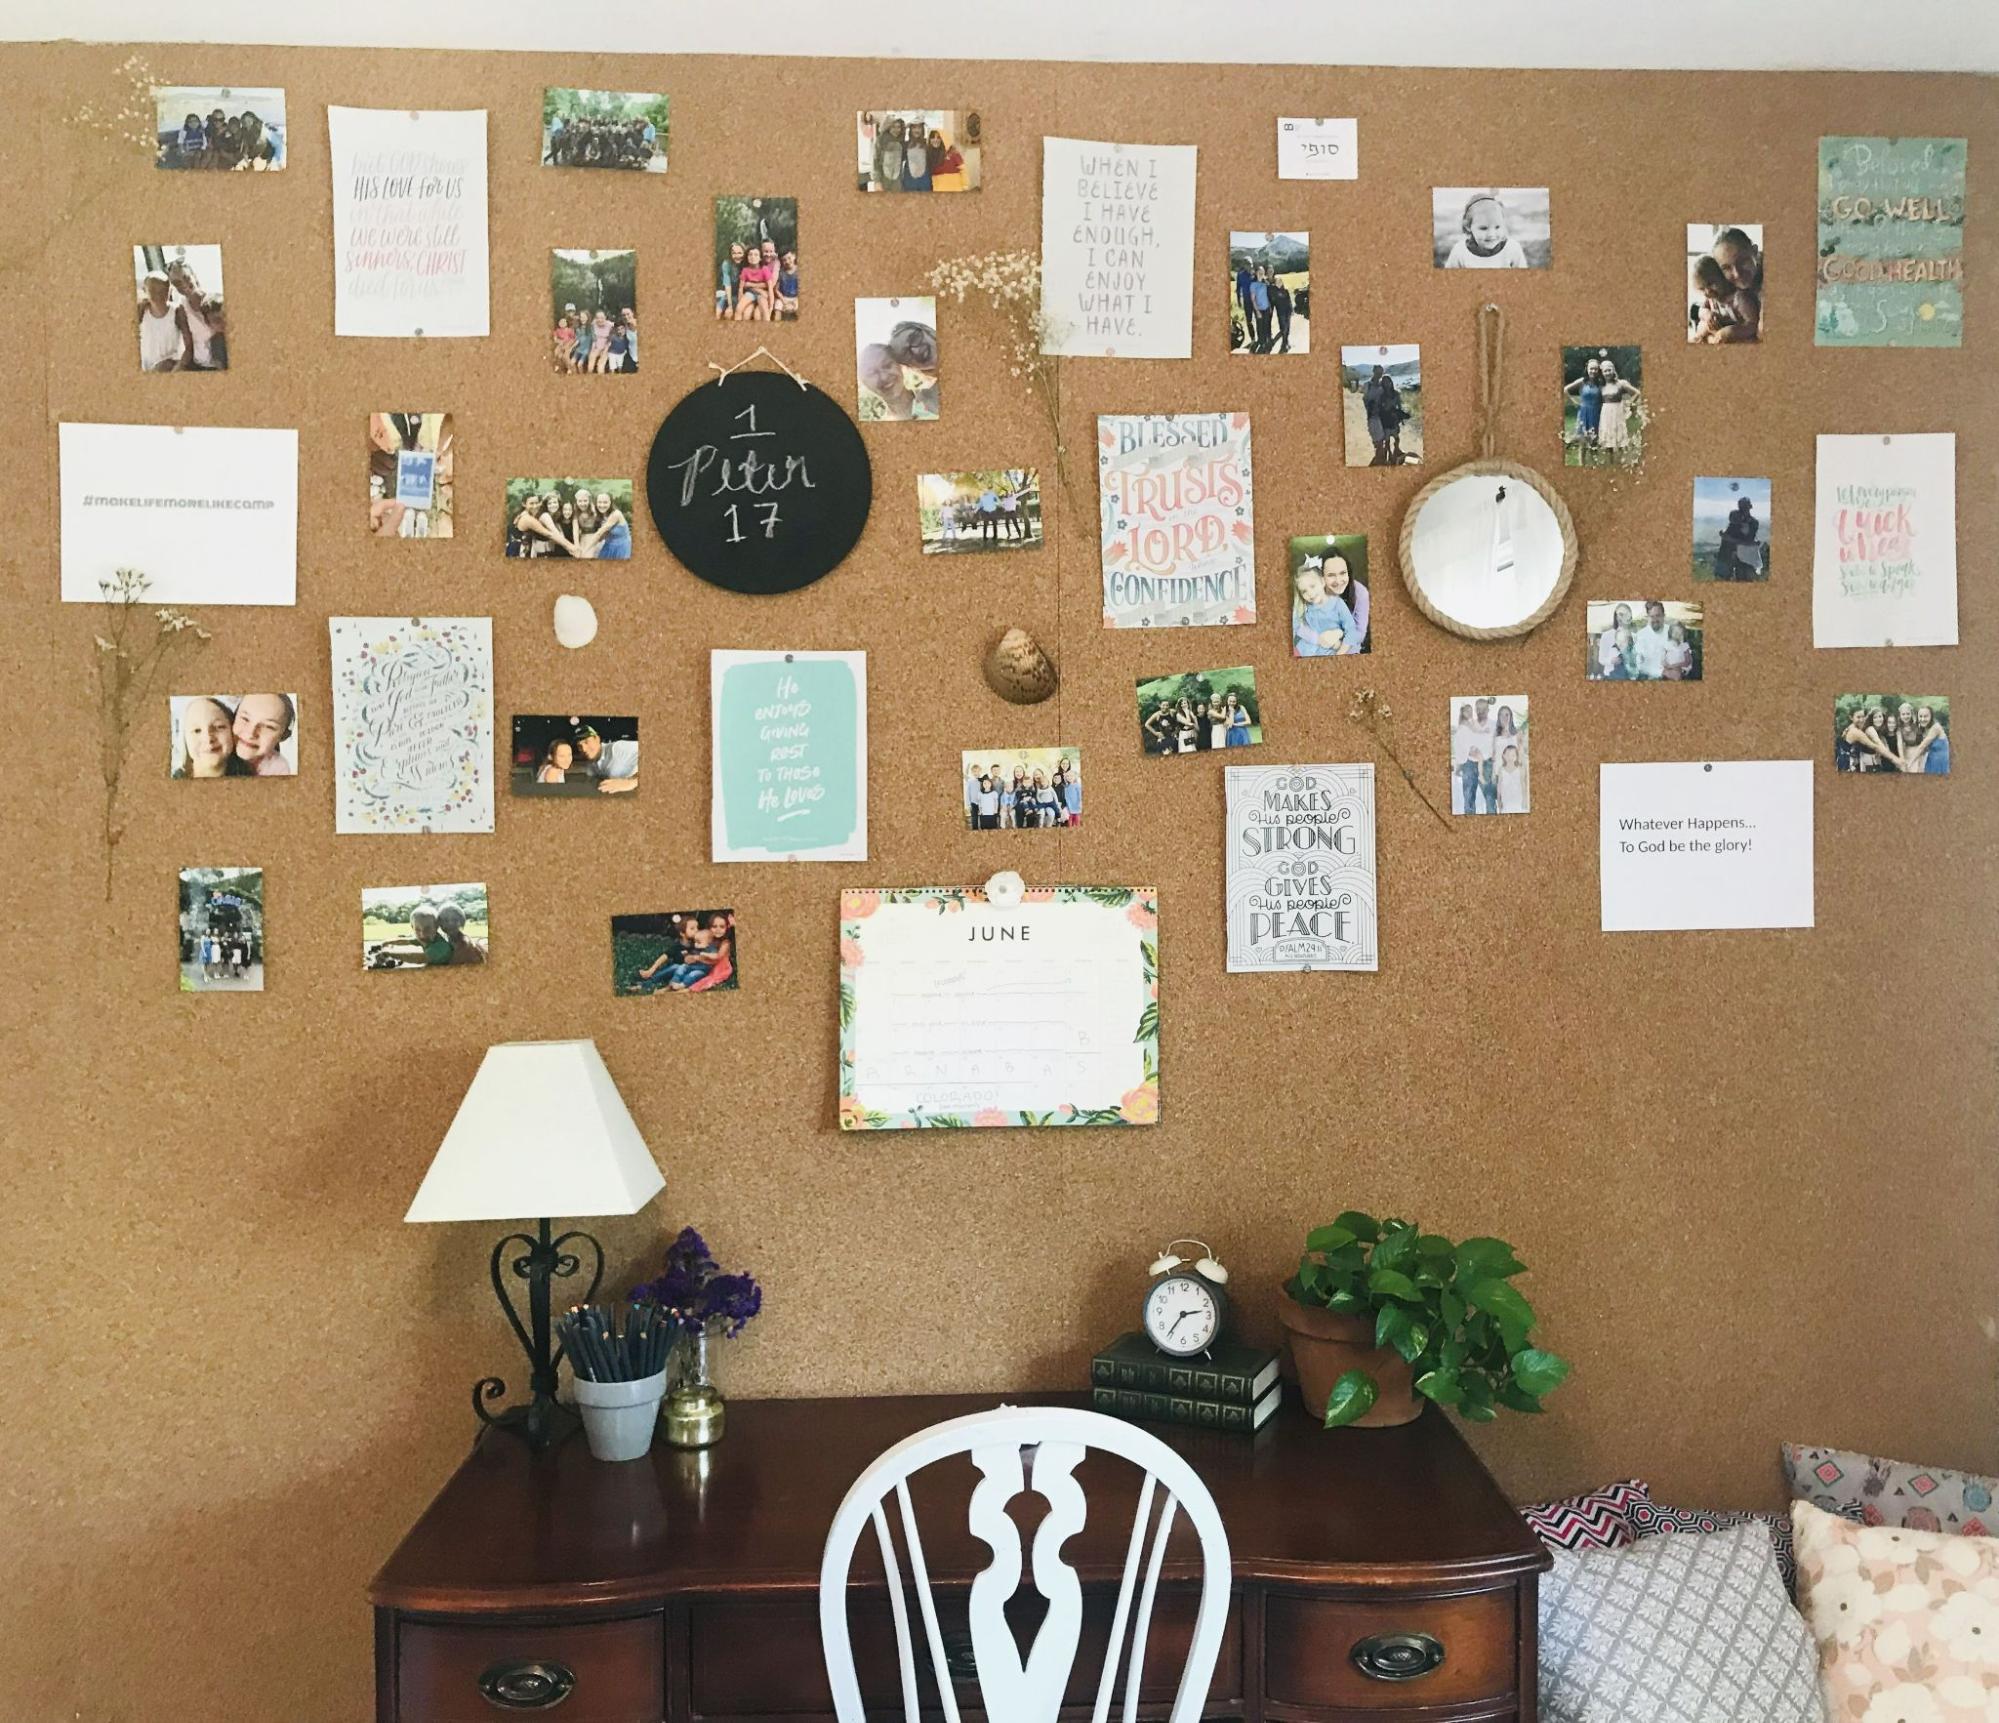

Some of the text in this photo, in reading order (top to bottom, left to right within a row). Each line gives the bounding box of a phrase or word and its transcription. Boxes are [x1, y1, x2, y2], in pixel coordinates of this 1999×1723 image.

[1080, 155, 1158, 178] WHEN I
[354, 176, 378, 201] HIS
[382, 176, 413, 200] LOVE
[1078, 178, 1159, 201] BELIEVE
[1084, 202, 1151, 223] I HAVE
[1833, 196, 1951, 222] GO WELL
[416, 249, 469, 276] CHRIST
[1088, 247, 1143, 268] I CAN
[1085, 271, 1145, 291] ENJOY
[1078, 293, 1152, 314] WHAT I
[1118, 418, 1228, 455] BLESSED
[667, 444, 816, 507] Peter
[1104, 453, 1243, 521] TRUSTS
[1110, 563, 1247, 606] CONFIDENCE
[777, 675, 799, 699] He
[1276, 776, 1317, 792] GOD
[758, 787, 779, 814] He
[1264, 790, 1332, 811] MAKES
[1286, 808, 1351, 826] people
[1619, 817, 1756, 831] Whatever Happens...
[1619, 838, 1752, 854] To God be the glory!
[1278, 861, 1319, 876] GOD
[1265, 875, 1332, 896] GIVES
[1287, 893, 1351, 912] people
[968, 925, 1031, 942] JUNE
[1168, 1286, 1175, 1295] 11
[1181, 1283, 1190, 1292] 12
[1160, 1296, 1168, 1304] 10
[1203, 1298, 1209, 1307] 2
[1156, 1307, 1163, 1316] 9
[1206, 1311, 1211, 1320] 3
[1180, 1336, 1186, 1345] 6
[1193, 1334, 1199, 1343] 5
